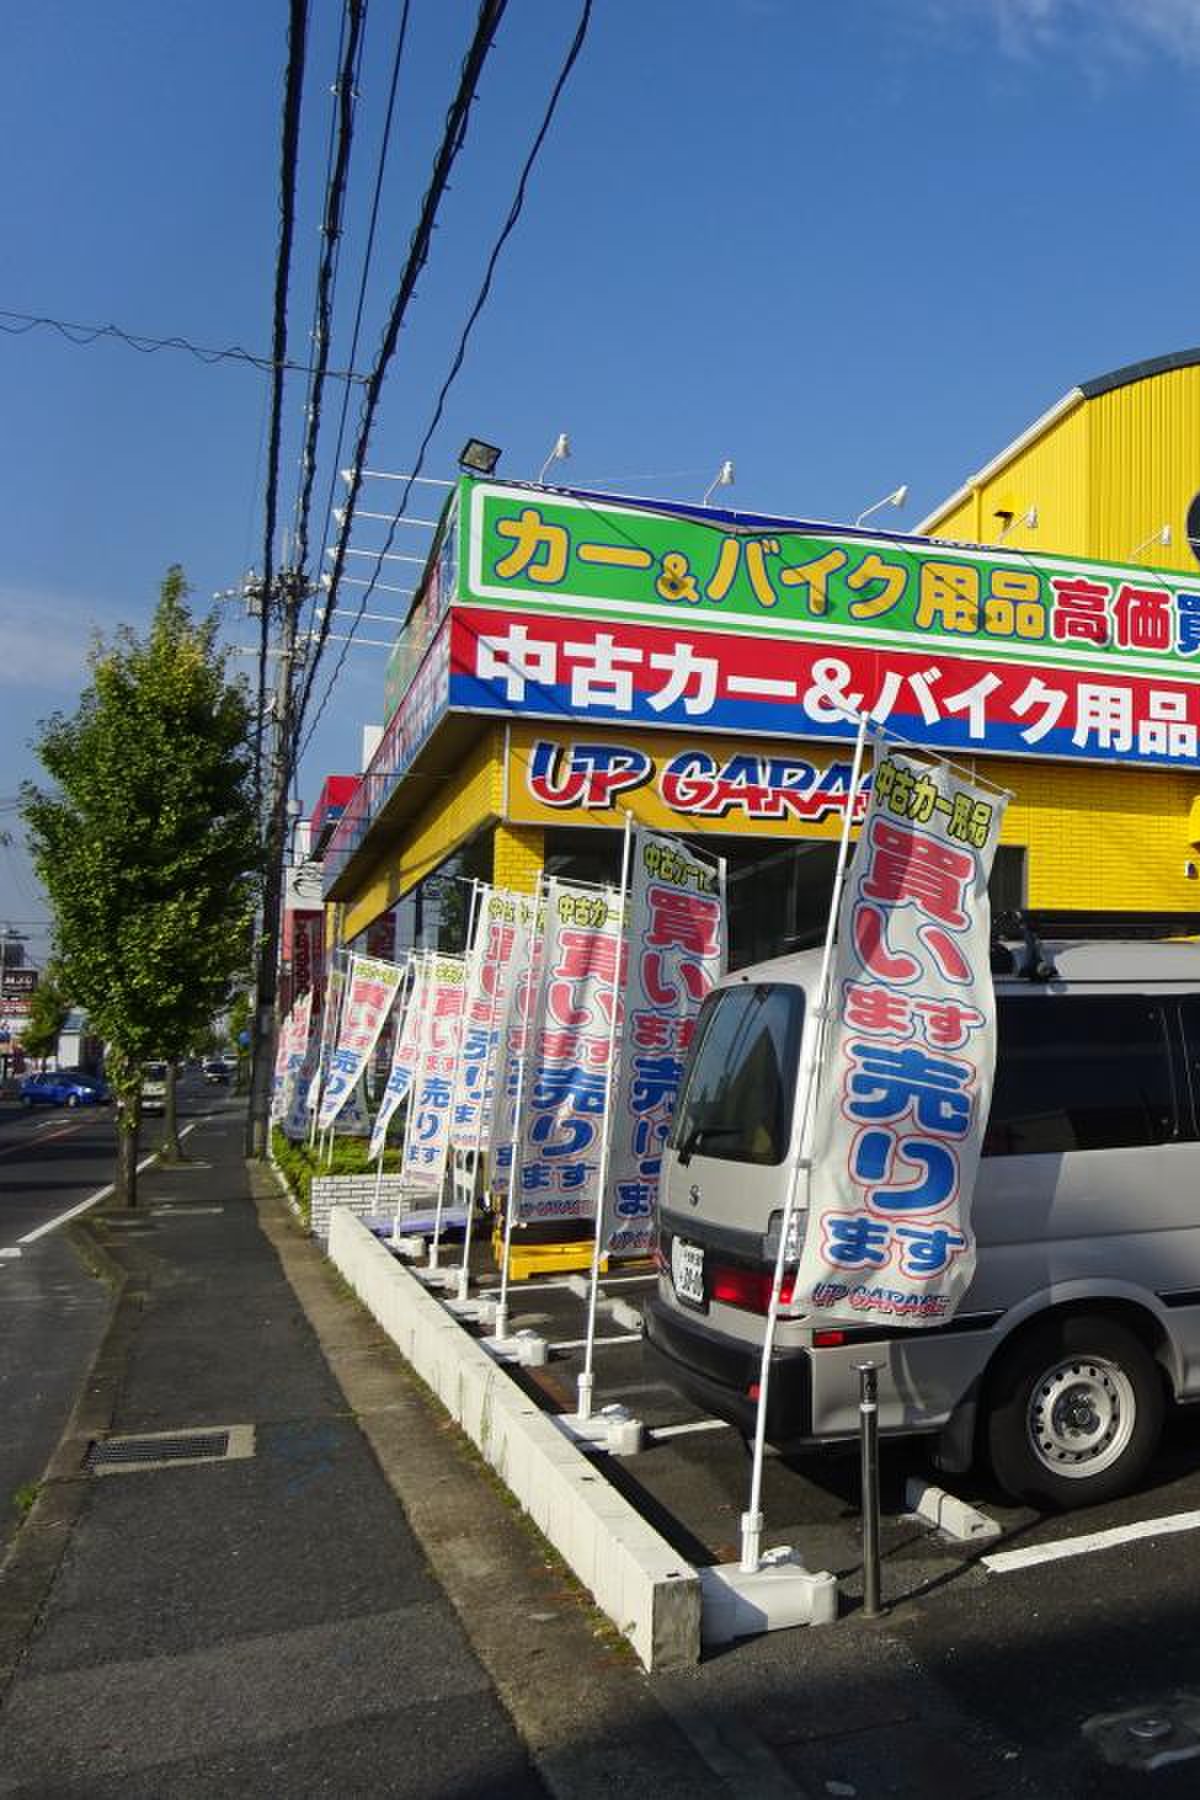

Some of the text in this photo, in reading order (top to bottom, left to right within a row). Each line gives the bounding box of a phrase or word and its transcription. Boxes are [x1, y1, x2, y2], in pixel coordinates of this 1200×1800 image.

[528, 740, 654, 809] UP
[874, 758, 992, 850] 中古カー用品
